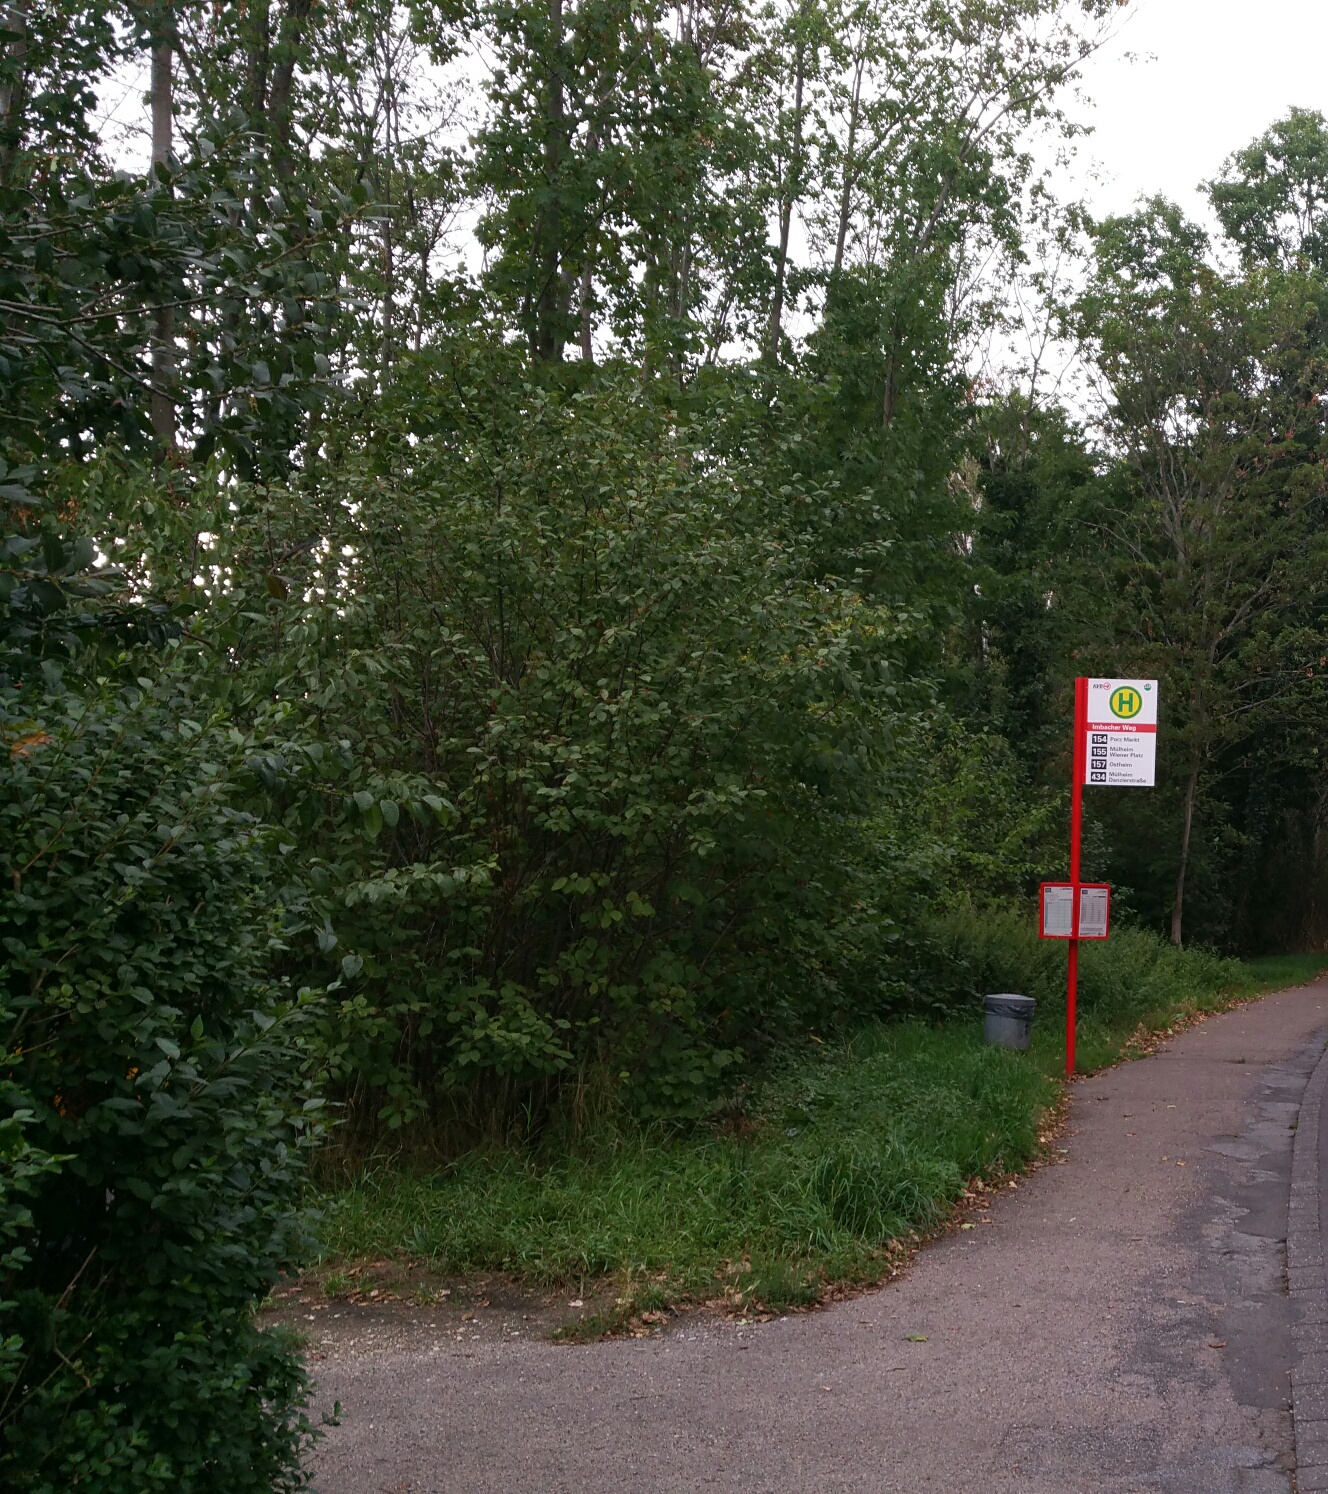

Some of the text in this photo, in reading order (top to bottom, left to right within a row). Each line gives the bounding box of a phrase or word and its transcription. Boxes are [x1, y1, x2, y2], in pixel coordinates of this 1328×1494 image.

[1118, 692, 1133, 713] H
[1122, 724, 1137, 732] Weg
[1093, 735, 1107, 743] 154
[1092, 748, 1107, 756] 155
[1092, 760, 1106, 768] 157
[1091, 773, 1106, 781] 434
